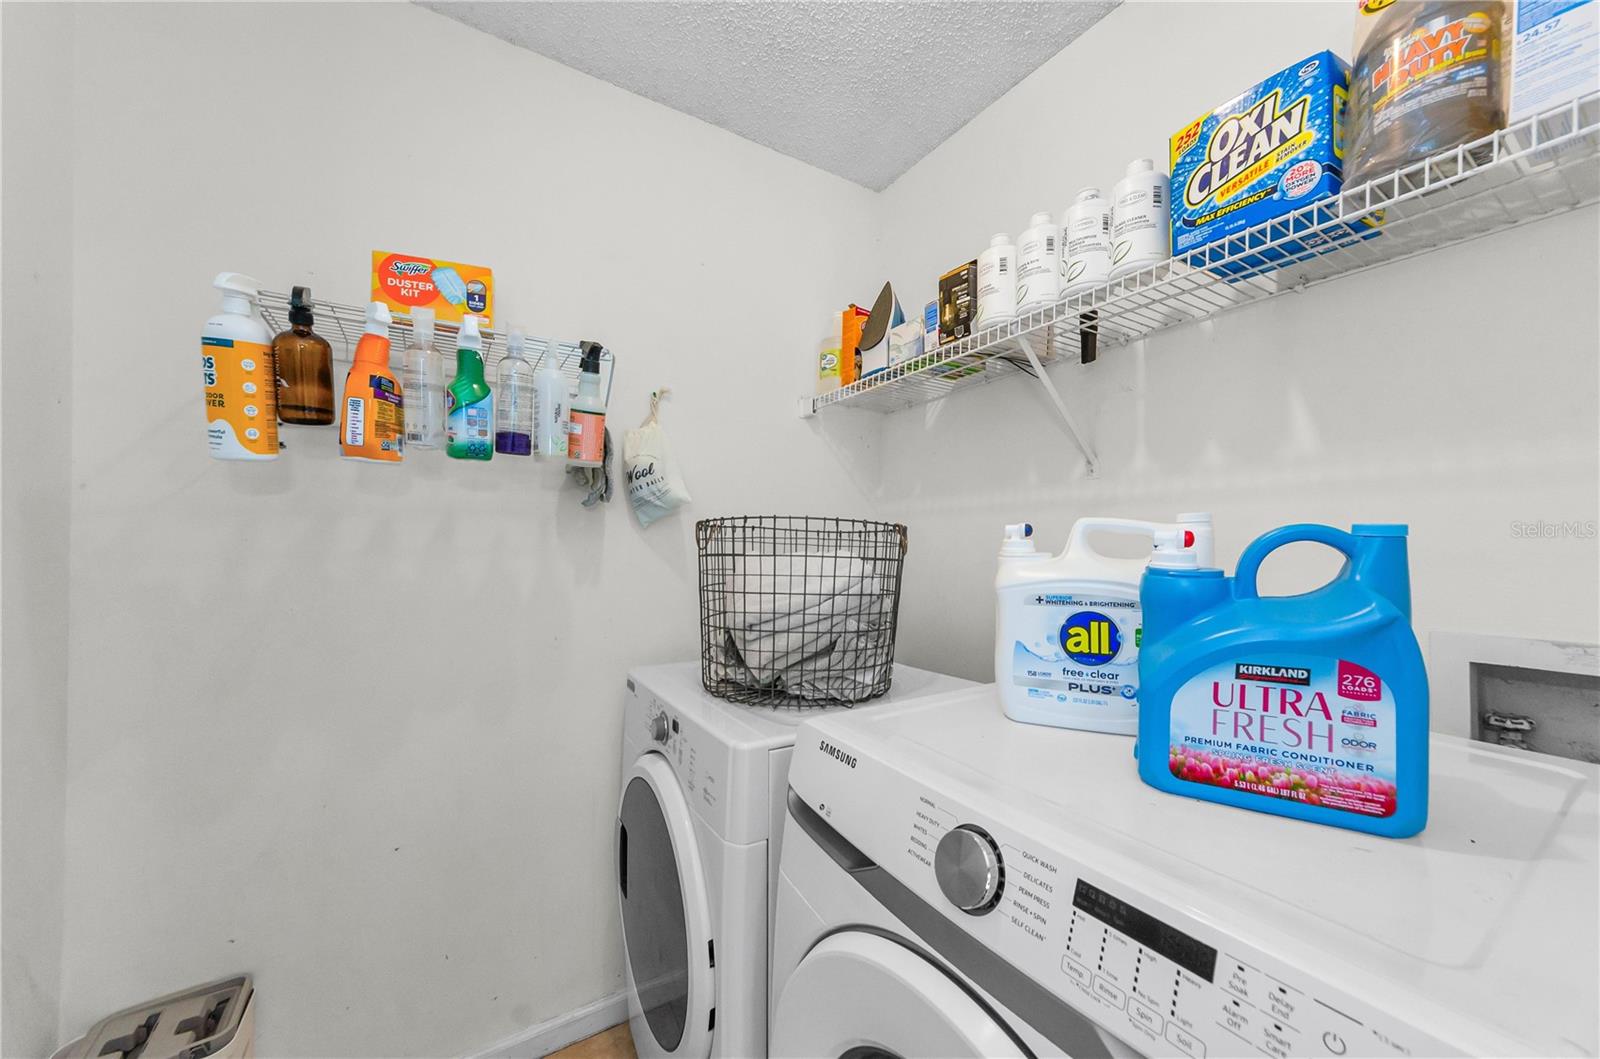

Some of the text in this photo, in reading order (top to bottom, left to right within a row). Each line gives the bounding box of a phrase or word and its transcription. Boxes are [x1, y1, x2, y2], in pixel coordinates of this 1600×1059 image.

[1387, 34, 1472, 96] DUTY
[1210, 91, 1280, 162] OXI
[1176, 122, 1200, 152] 252
[1187, 98, 1307, 205] CLEAN
[1276, 140, 1307, 162] REMOVER
[1277, 143, 1295, 157] STAIN
[1285, 168, 1314, 183] MORE
[1290, 161, 1314, 175] 20%
[1219, 159, 1270, 198] VERSATILE
[1285, 173, 1315, 188] OXYGEN
[1196, 212, 1215, 226] MAX
[390, 261, 430, 276] Swiffer
[387, 277, 433, 291] DUSTER
[400, 287, 420, 298] KIT
[473, 294, 479, 302] 1
[626, 462, 655, 484] Wool
[1066, 620, 1110, 655] all
[1062, 667, 1084, 678] free
[1091, 669, 1120, 680] clear
[1239, 664, 1309, 679] KIRKLAND
[1342, 674, 1376, 689] 276
[1212, 681, 1333, 721] ULTRA
[1341, 709, 1377, 720] FABRIC
[1212, 708, 1334, 753] FRESH
[1341, 737, 1377, 750] ODOR
[819, 740, 857, 769] SAMSUNG
[1184, 736, 1375, 773] PREMIUM FABRIC CONDITIONER
[1211, 749, 1337, 775] SPRING FRESH SCENT
[1022, 851, 1057, 874] QUICK WASH
[1023, 872, 1053, 893] DELICATES
[1018, 886, 1050, 909] PERM PRESS
[1011, 916, 1024, 928] SELF
[1066, 962, 1084, 978] Temp
[1233, 972, 1247, 985] Pre
[1099, 983, 1118, 1001] Rinse
[1229, 981, 1248, 997] Soak
[1268, 991, 1294, 1013] Delay
[1136, 1007, 1153, 1024] Spin
[1222, 1004, 1248, 1024] Alarm
[1271, 1003, 1290, 1020] End
[1227, 1017, 1241, 1030] Off
[1176, 1034, 1193, 1050] Soil
[1264, 1027, 1292, 1051] Smart
[1265, 1040, 1287, 1058] Care
